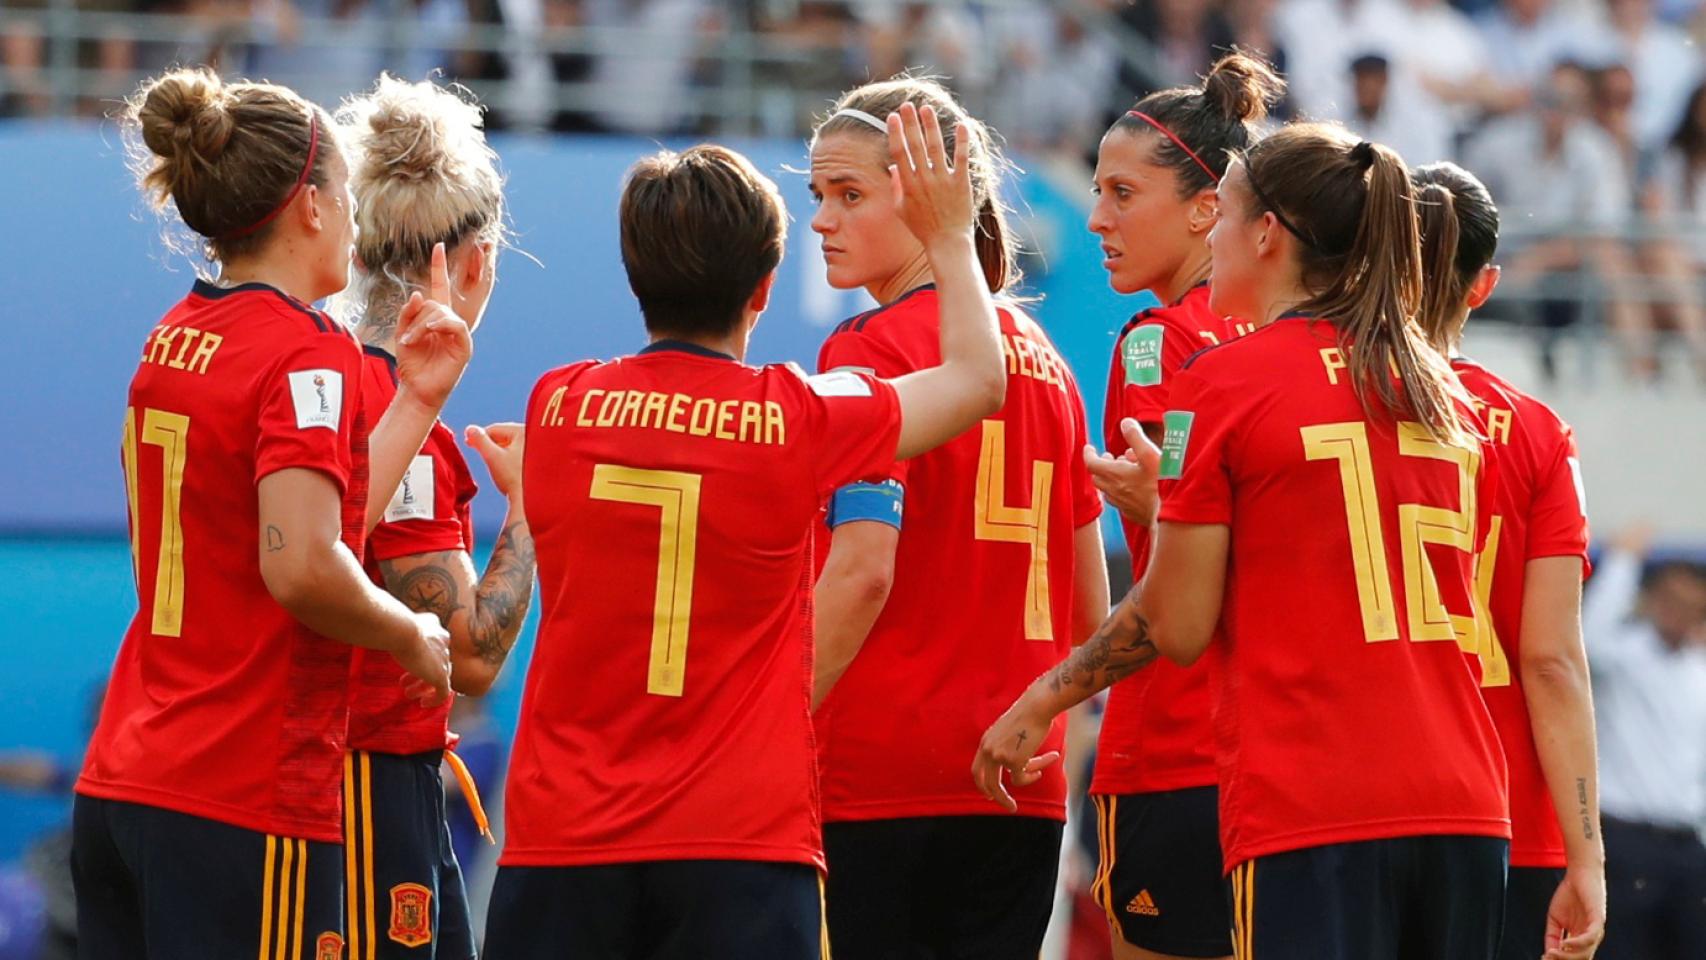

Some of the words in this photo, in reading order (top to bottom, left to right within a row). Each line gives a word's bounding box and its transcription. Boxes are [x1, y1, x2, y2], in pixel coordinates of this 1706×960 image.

[576, 389, 786, 445] CORREDERA
[1135, 359, 1155, 370] FIFA
[589, 463, 702, 697] 7
[974, 419, 1054, 641] 4
[1300, 421, 1479, 654] 12
[1126, 904, 1159, 916] adidas
